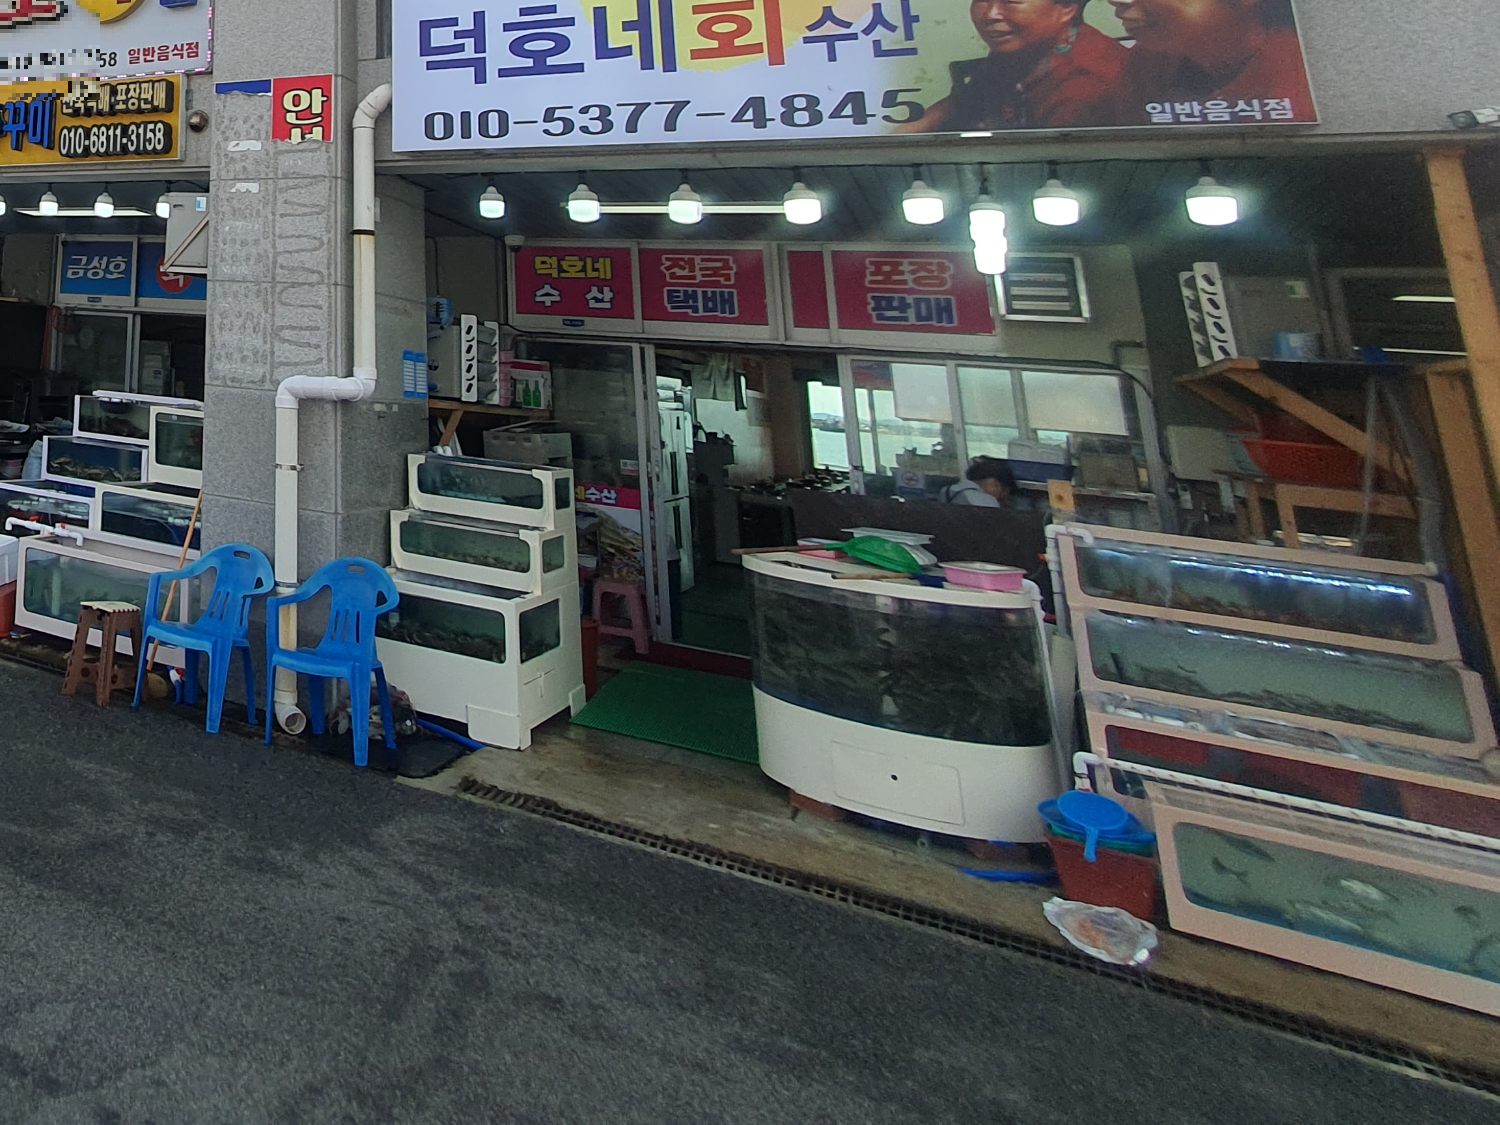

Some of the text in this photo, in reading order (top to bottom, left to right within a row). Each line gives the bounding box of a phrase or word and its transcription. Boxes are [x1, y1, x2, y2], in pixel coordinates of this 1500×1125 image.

[127, 41, 200, 65] 일반음식점
[424, 88, 925, 141] 010-5377-4845
[1145, 97, 1293, 123] 일반음식점
[59, 125, 165, 155] 010-6811-3158
[66, 254, 128, 280] 금성호
[533, 254, 951, 289] 덕호네 전국 포장
[667, 288, 737, 316] 택배
[871, 294, 956, 327] 판매
